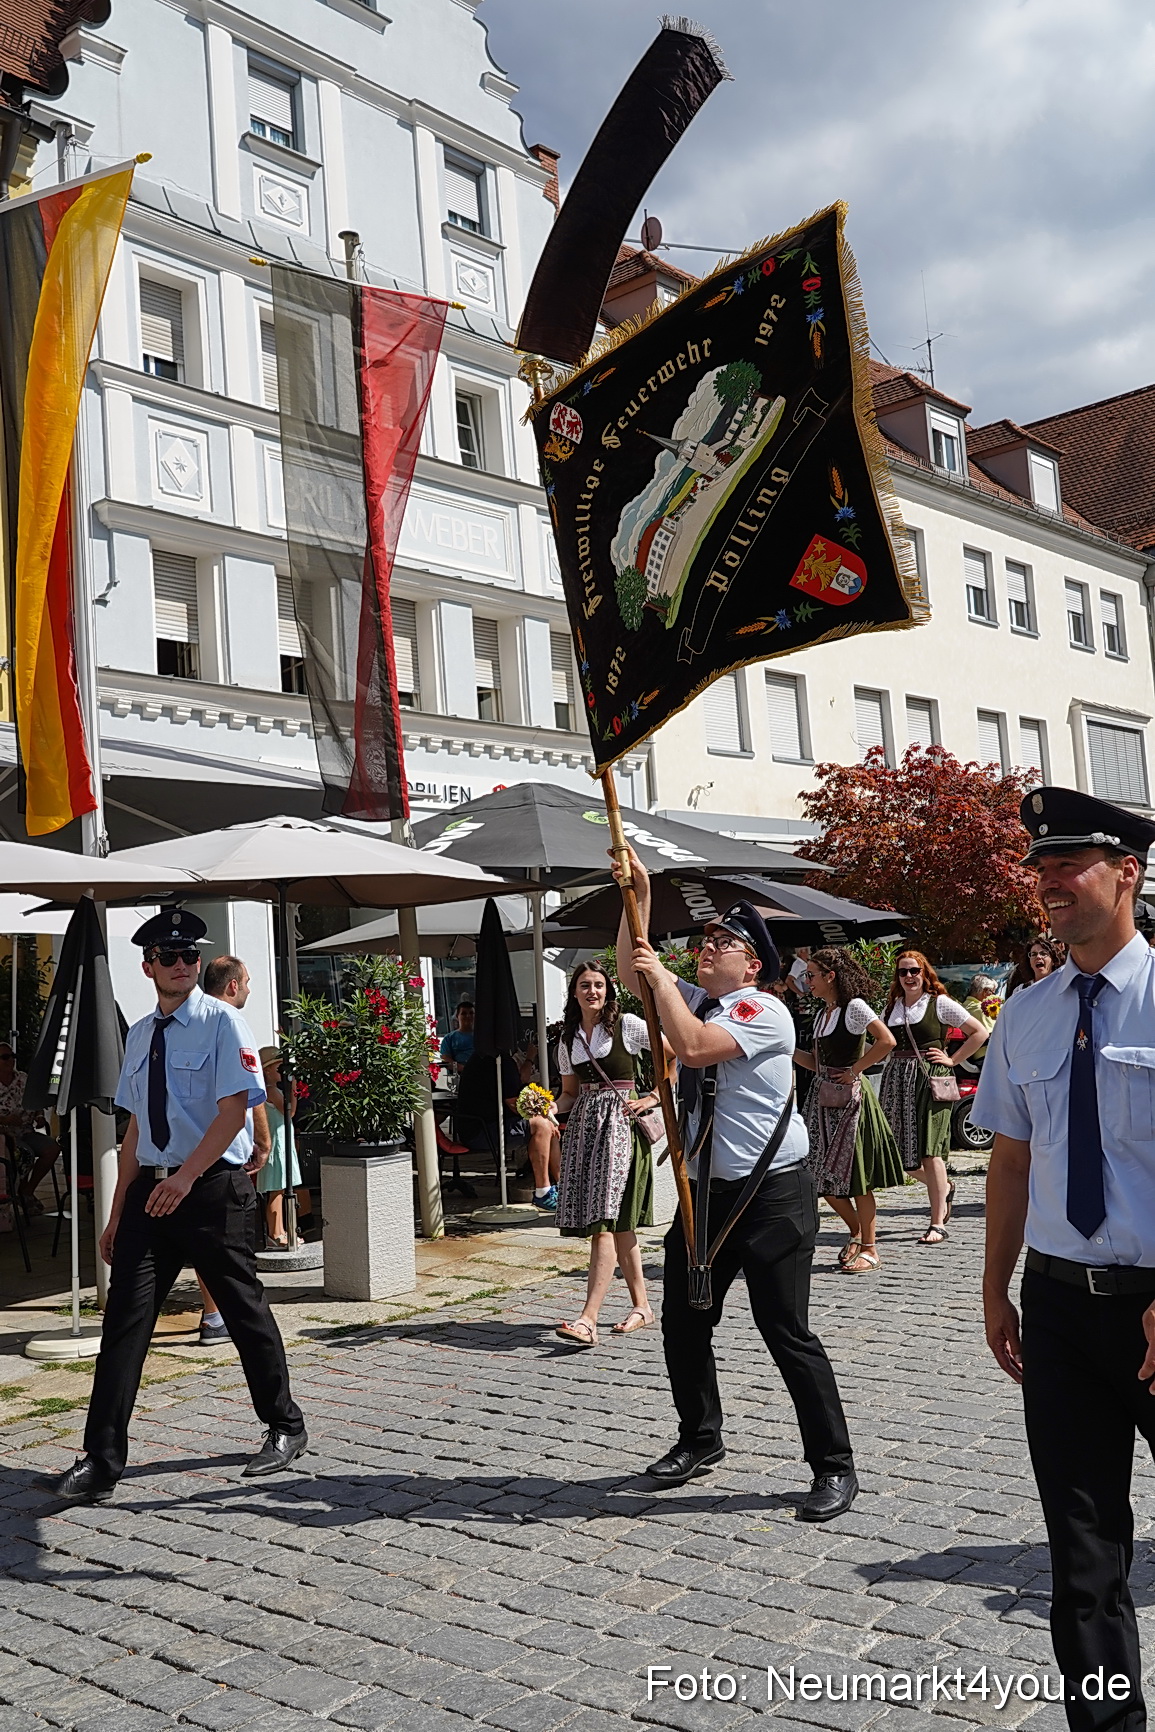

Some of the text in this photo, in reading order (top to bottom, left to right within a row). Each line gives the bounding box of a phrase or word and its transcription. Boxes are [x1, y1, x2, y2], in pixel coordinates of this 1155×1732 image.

[755, 294, 786, 345] 1972
[575, 338, 712, 620] Freiwillige Feuerwehr
[405, 509, 501, 559] WEBER
[705, 467, 790, 593] Pölling
[605, 646, 627, 695] 1872
